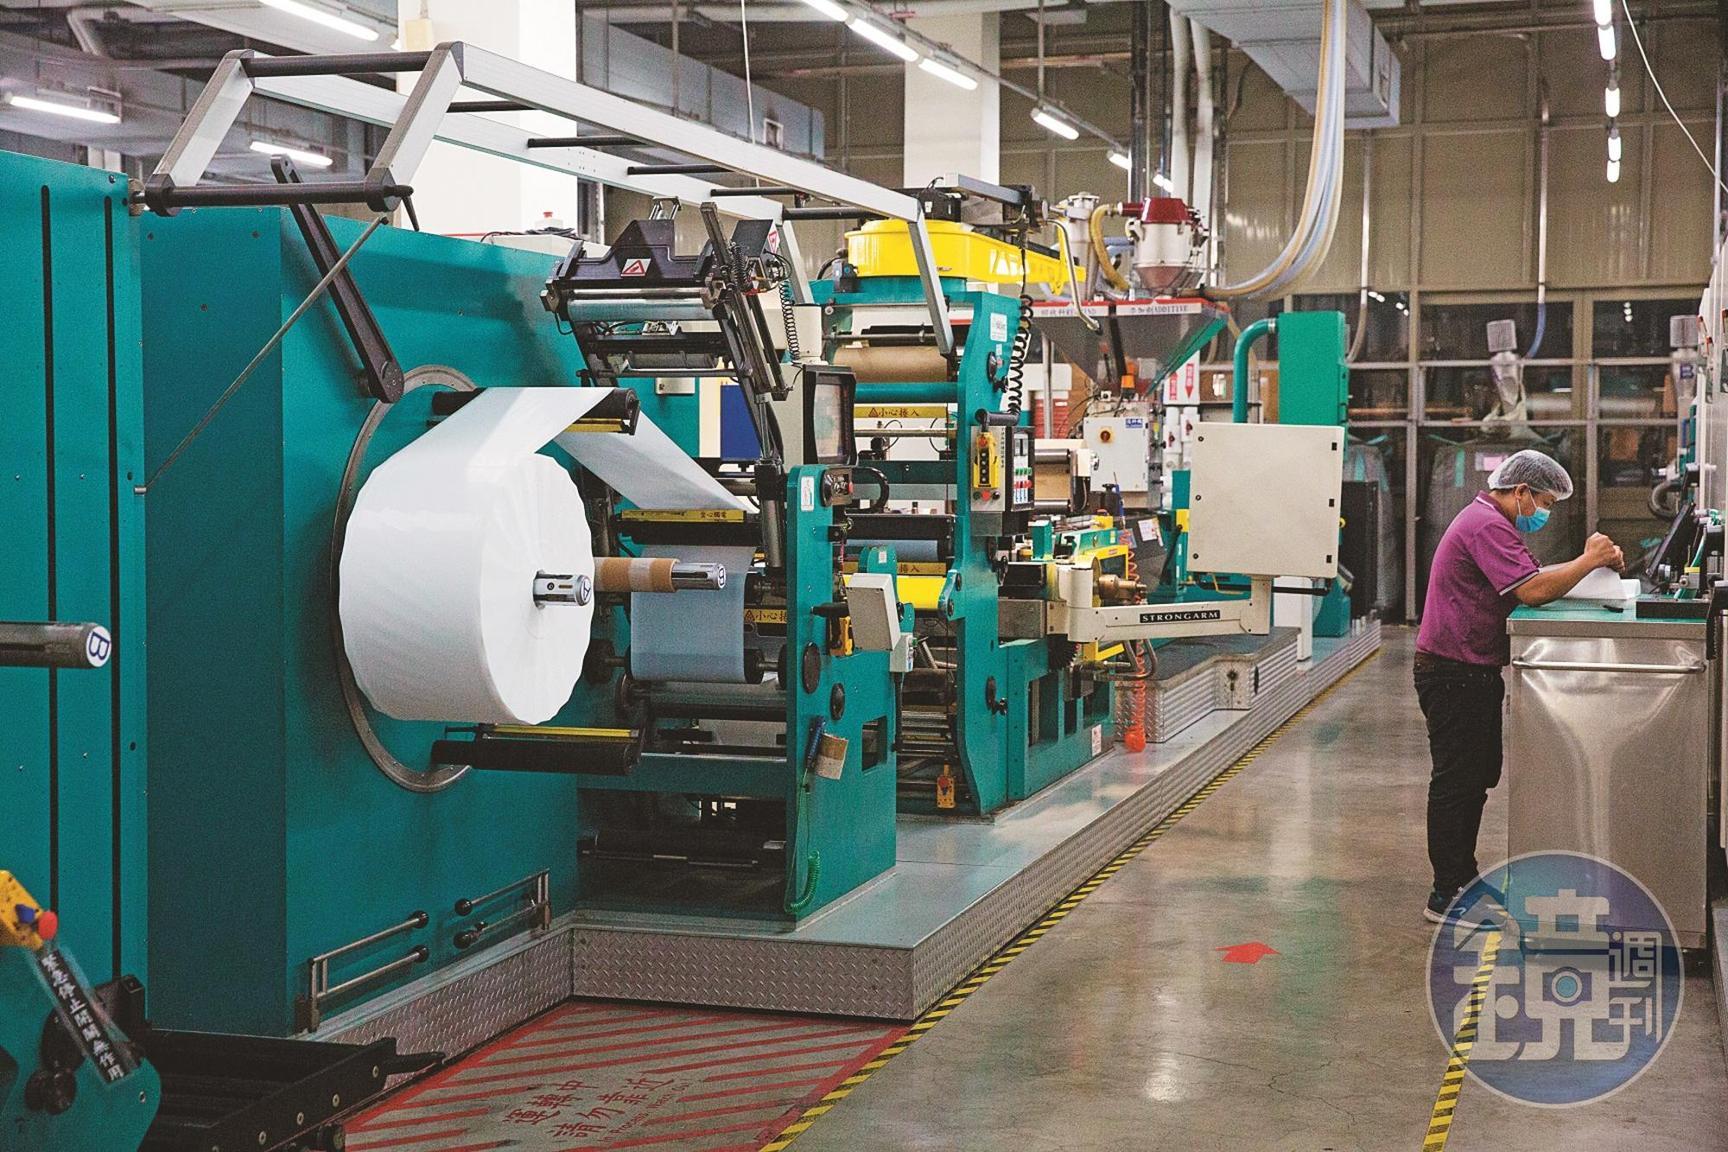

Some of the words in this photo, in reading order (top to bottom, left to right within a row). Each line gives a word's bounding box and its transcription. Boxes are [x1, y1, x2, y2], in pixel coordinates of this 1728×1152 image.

[1142, 611, 1219, 622] STRONGARM
[88, 631, 110, 661] B
[502, 1079, 600, 1126] 運轉中
[548, 1077, 675, 1139] 請勿靠近
